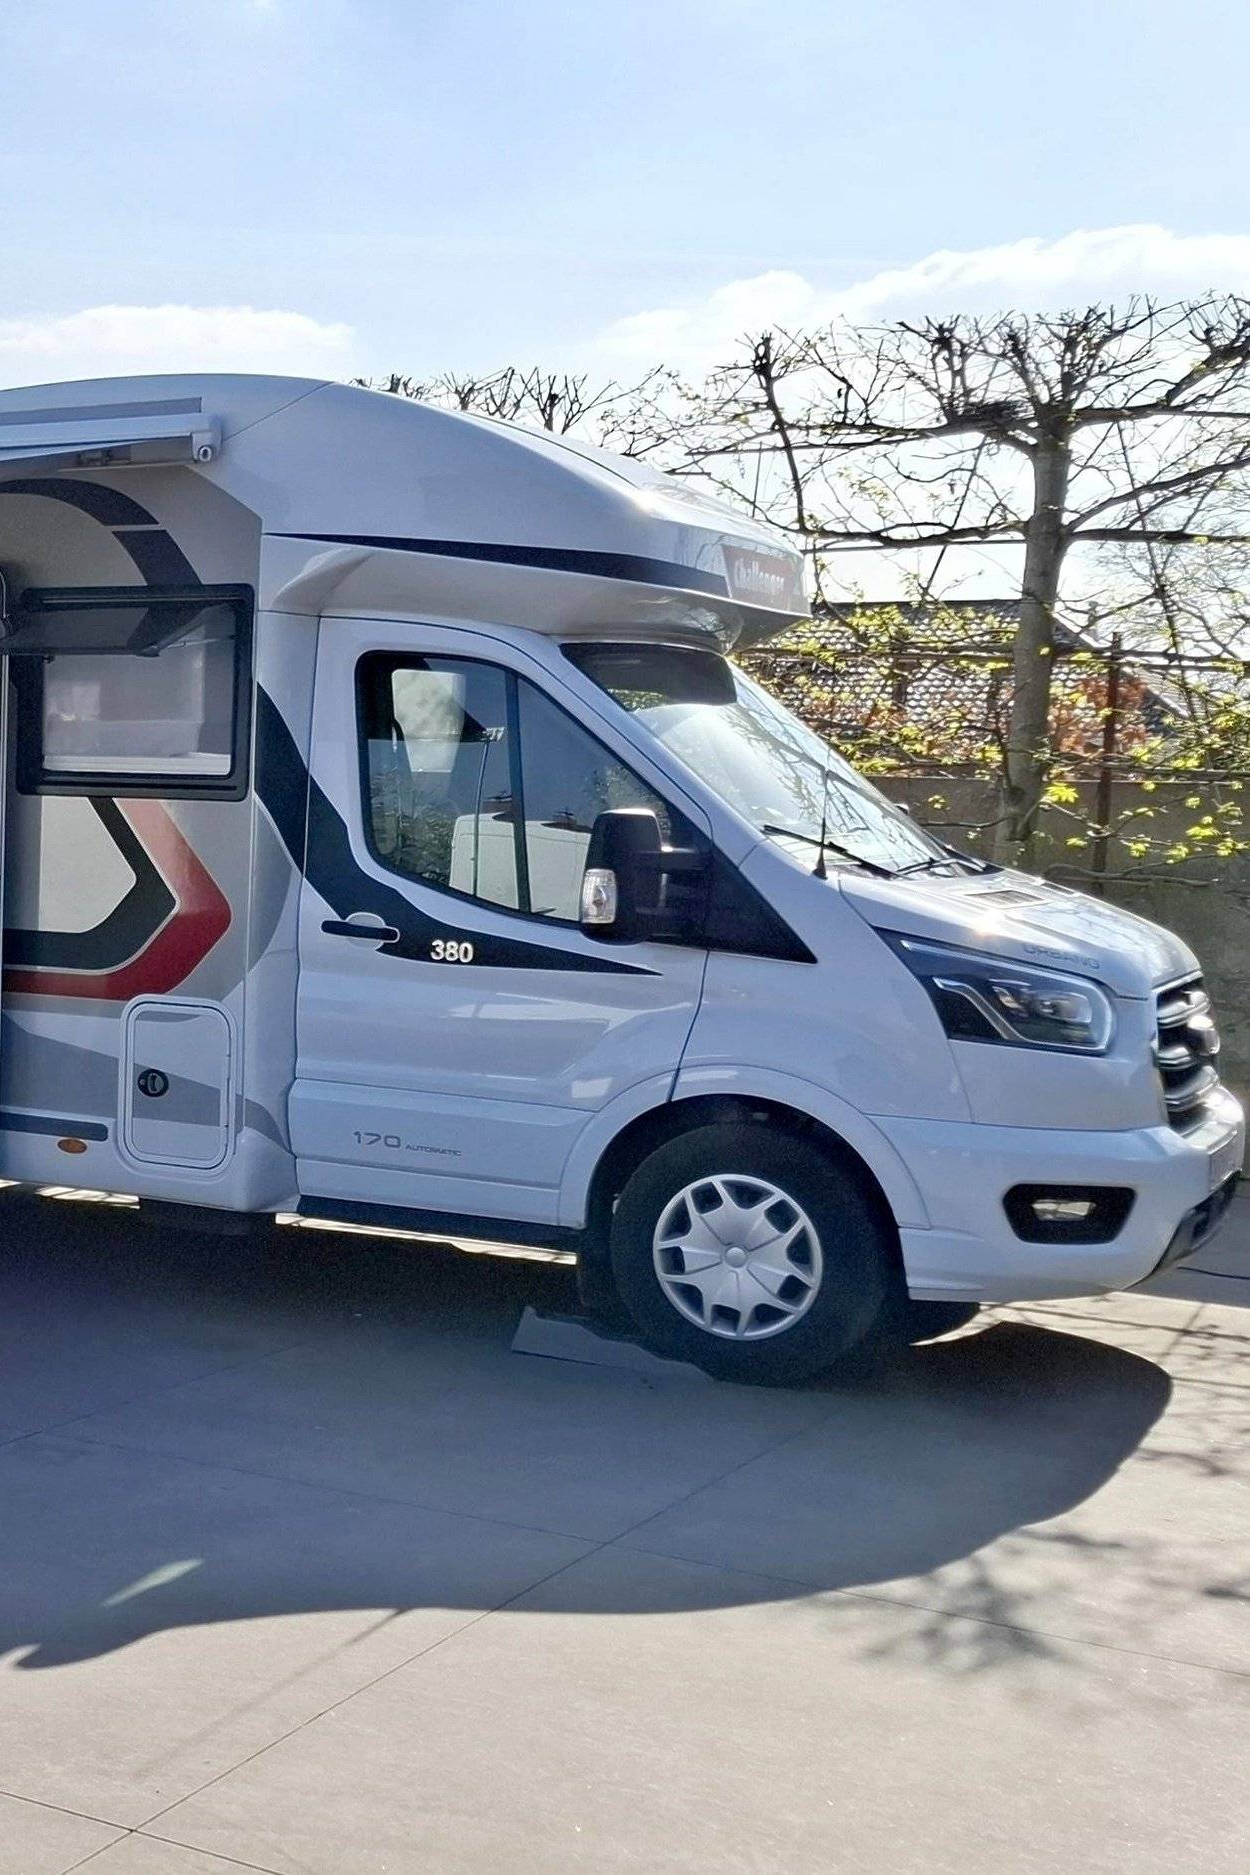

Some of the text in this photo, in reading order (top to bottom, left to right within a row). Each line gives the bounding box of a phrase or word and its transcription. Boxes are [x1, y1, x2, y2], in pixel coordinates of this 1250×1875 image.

[430, 939, 474, 963] 380
[353, 1130, 462, 1157] 170 AUTOMATIC
